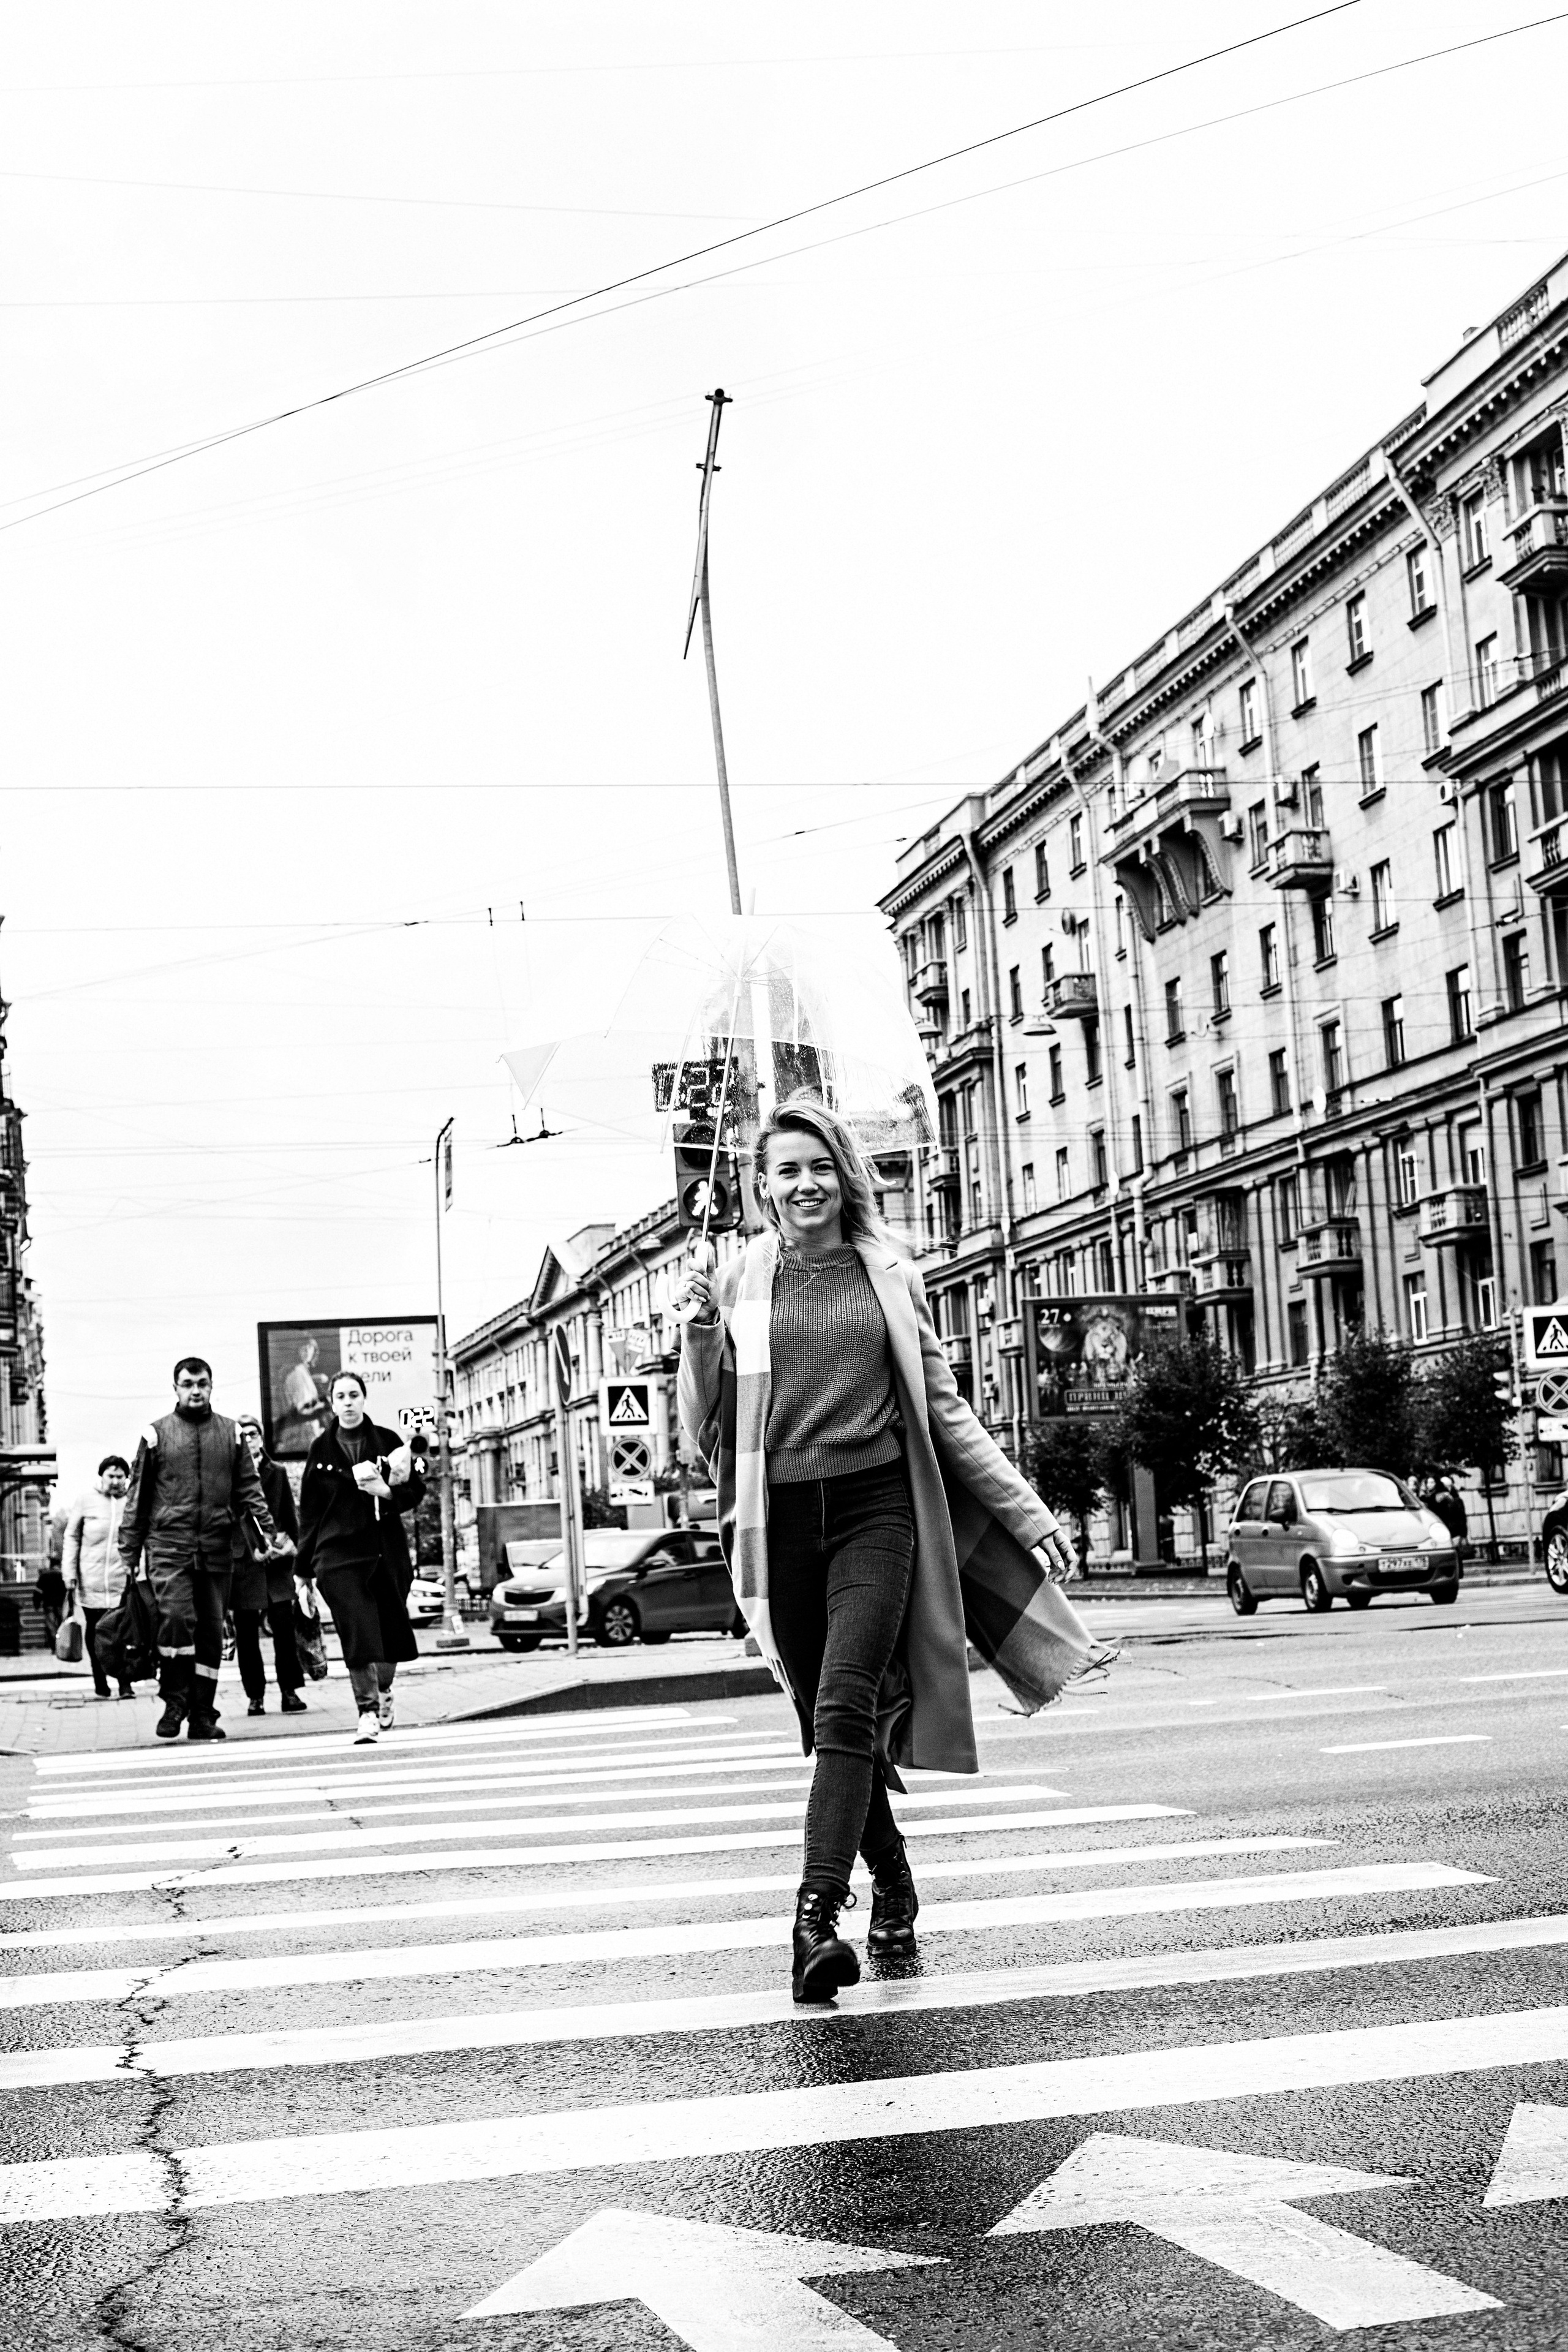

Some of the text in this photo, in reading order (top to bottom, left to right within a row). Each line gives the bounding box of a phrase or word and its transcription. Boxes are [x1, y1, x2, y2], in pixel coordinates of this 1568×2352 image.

[1040, 1308, 1060, 1324] 27
[347, 1329, 413, 1346] Дорога
[362, 1347, 412, 1363] твоей
[360, 1372, 391, 1383] ели
